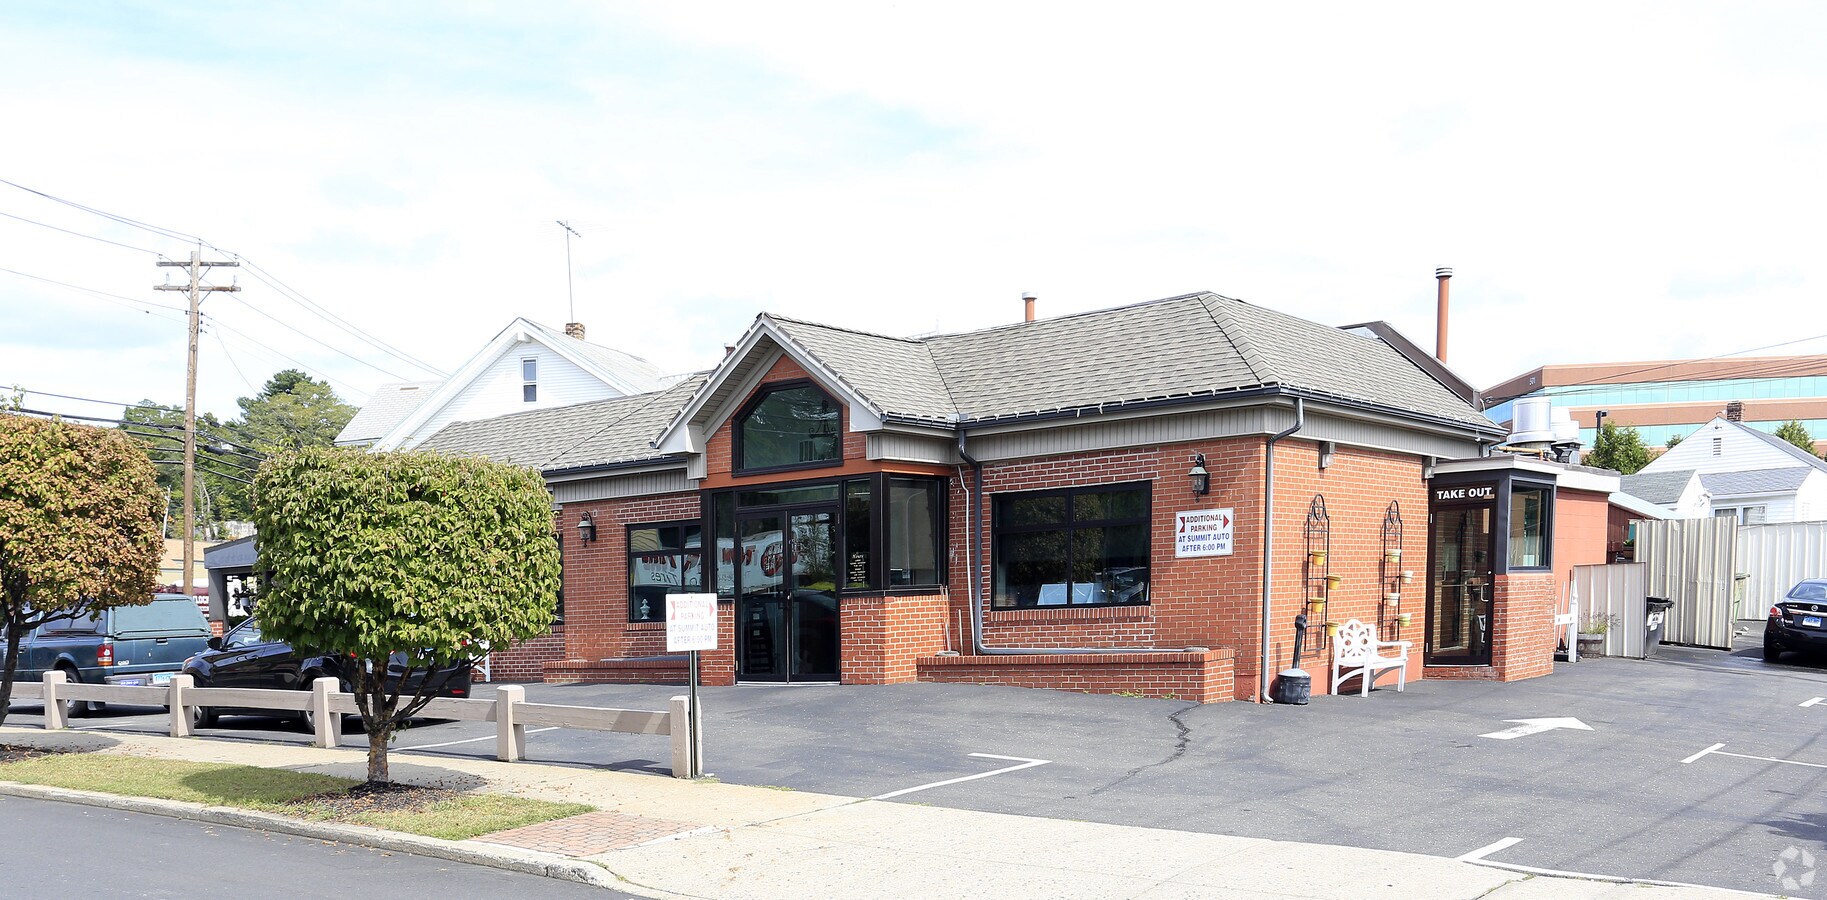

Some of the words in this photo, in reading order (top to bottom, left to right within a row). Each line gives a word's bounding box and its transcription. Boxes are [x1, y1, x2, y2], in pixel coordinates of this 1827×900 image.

[1436, 489, 1466, 500] TAKE
[1468, 486, 1492, 498] OUT
[1186, 514, 1223, 523] ADDITIONAL
[1190, 523, 1217, 532] PARKING
[1178, 535, 1186, 543] AT
[1187, 533, 1211, 543] SUMMIT
[1212, 532, 1230, 541] AUTO
[1181, 544, 1201, 552] AFTER
[1202, 543, 1216, 551] 6:00
[1216, 542, 1226, 550] PM
[676, 600, 709, 609] ADDITIONAL
[680, 611, 705, 620] PARKING
[669, 624, 676, 632] AT
[678, 623, 699, 632] SUMMIT
[700, 623, 715, 631] AUTO
[673, 635, 691, 644] AFTER
